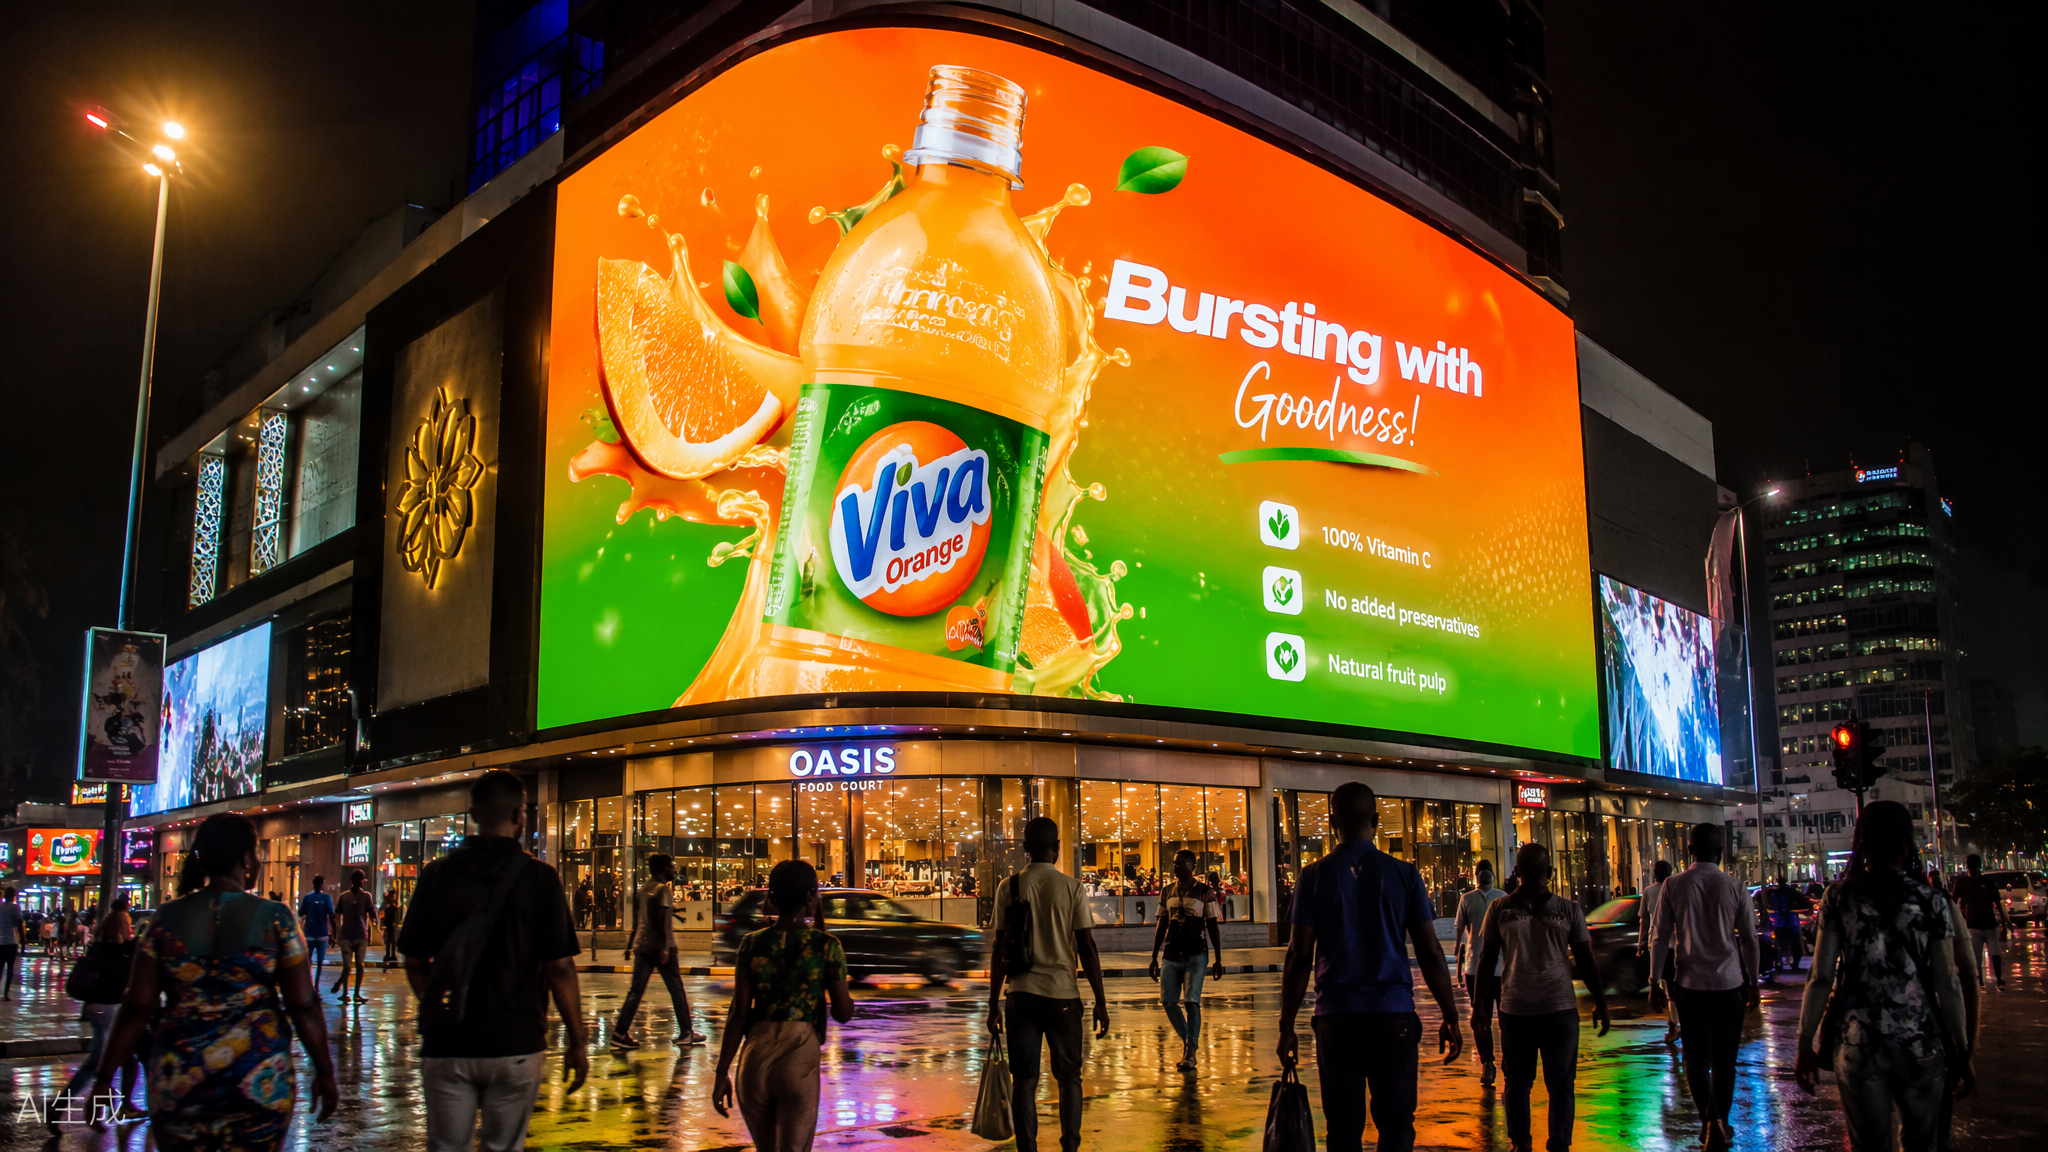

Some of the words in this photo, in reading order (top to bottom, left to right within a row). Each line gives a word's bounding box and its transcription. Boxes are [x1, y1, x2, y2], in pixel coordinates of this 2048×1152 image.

[1103, 258, 1382, 386] Bursting
[1395, 340, 1483, 398] with
[1233, 360, 1421, 447] Goodness!
[840, 455, 985, 582] Viva
[886, 533, 963, 584] Orange
[1322, 526, 1363, 552] 100%
[1366, 536, 1418, 565] Vitamin
[1422, 552, 1431, 569] C
[1325, 590, 1347, 610] No
[1351, 596, 1395, 620] added
[1399, 608, 1480, 638] preservatives
[1328, 654, 1383, 680] Natural
[1386, 663, 1416, 686] fruit
[1419, 672, 1446, 694] pulp
[789, 746, 896, 777] OASIS
[800, 782, 834, 793] FOOD
[840, 780, 884, 791] COURT
